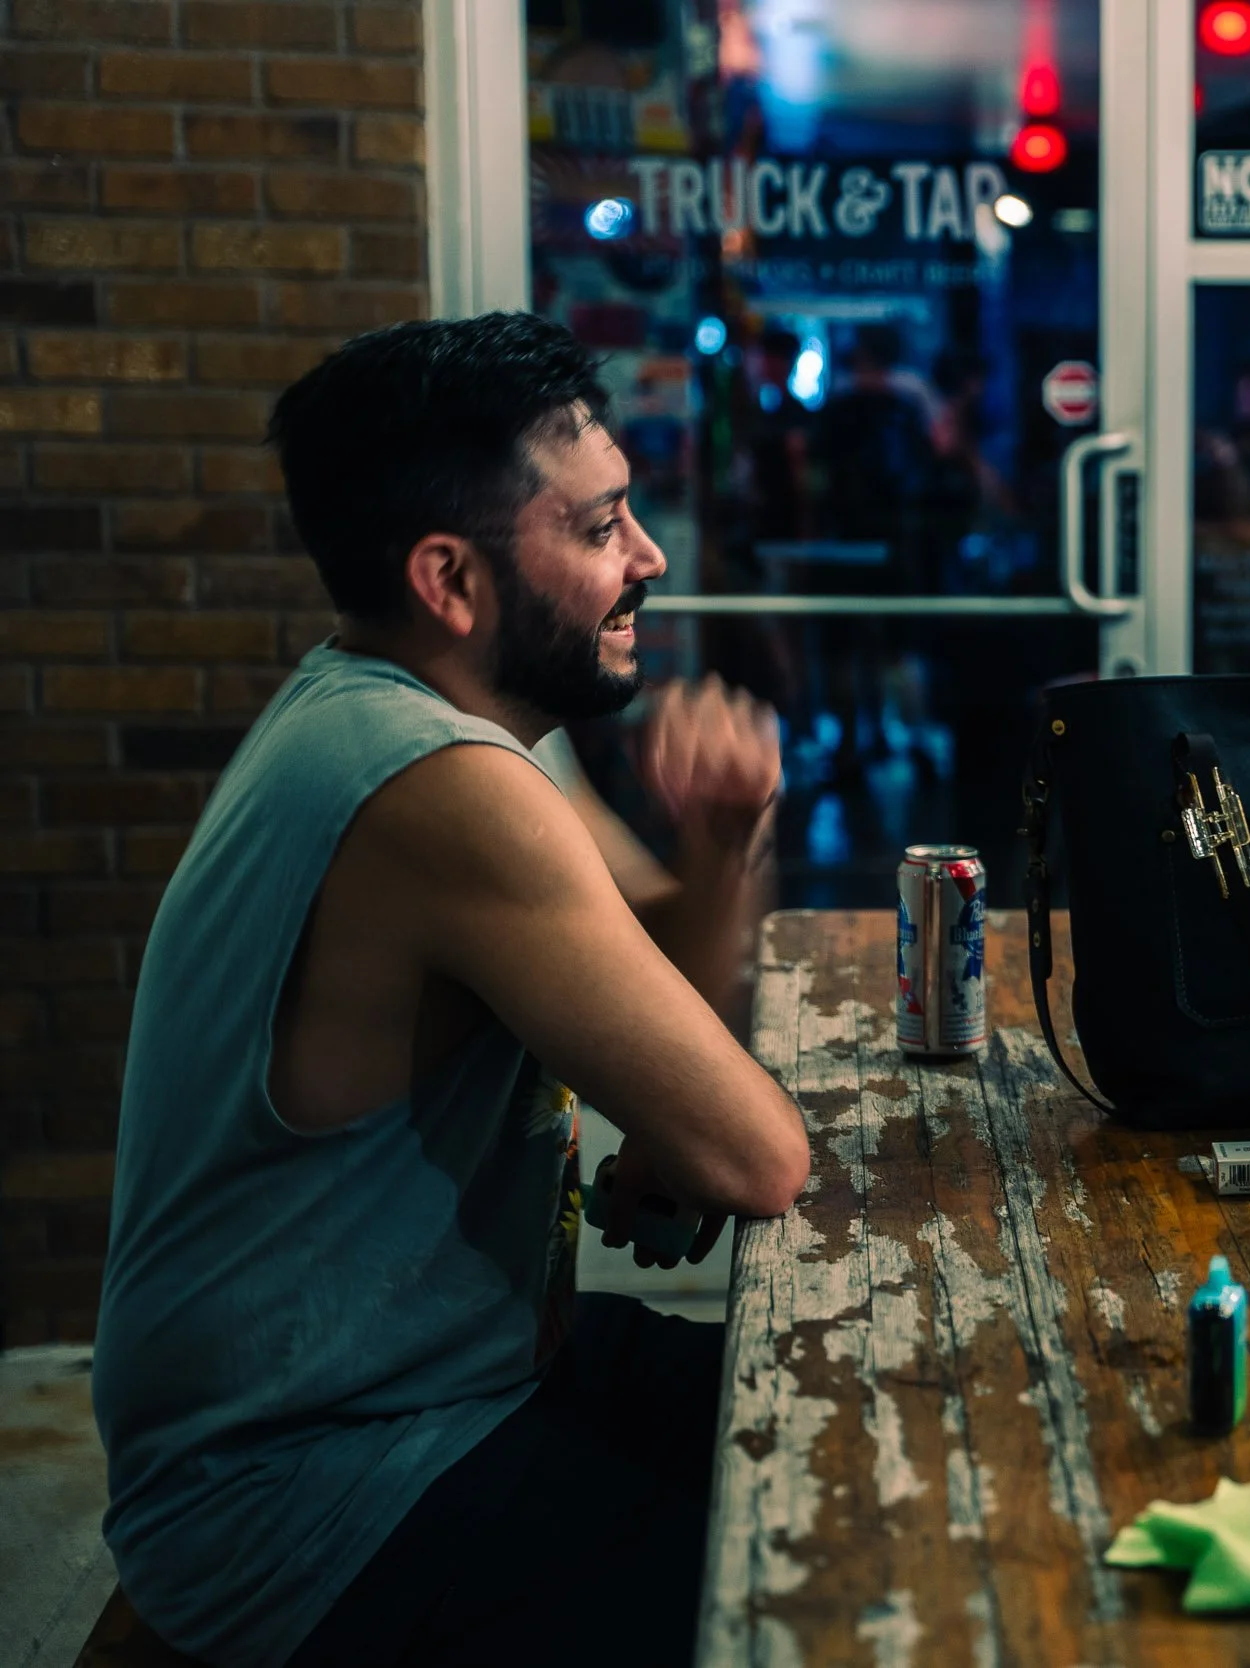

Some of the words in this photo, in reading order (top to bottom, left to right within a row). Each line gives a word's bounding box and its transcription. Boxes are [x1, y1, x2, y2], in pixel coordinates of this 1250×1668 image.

[629, 159, 829, 239] TRUCK
[833, 165, 893, 239] &
[891, 159, 1008, 241] TAP
